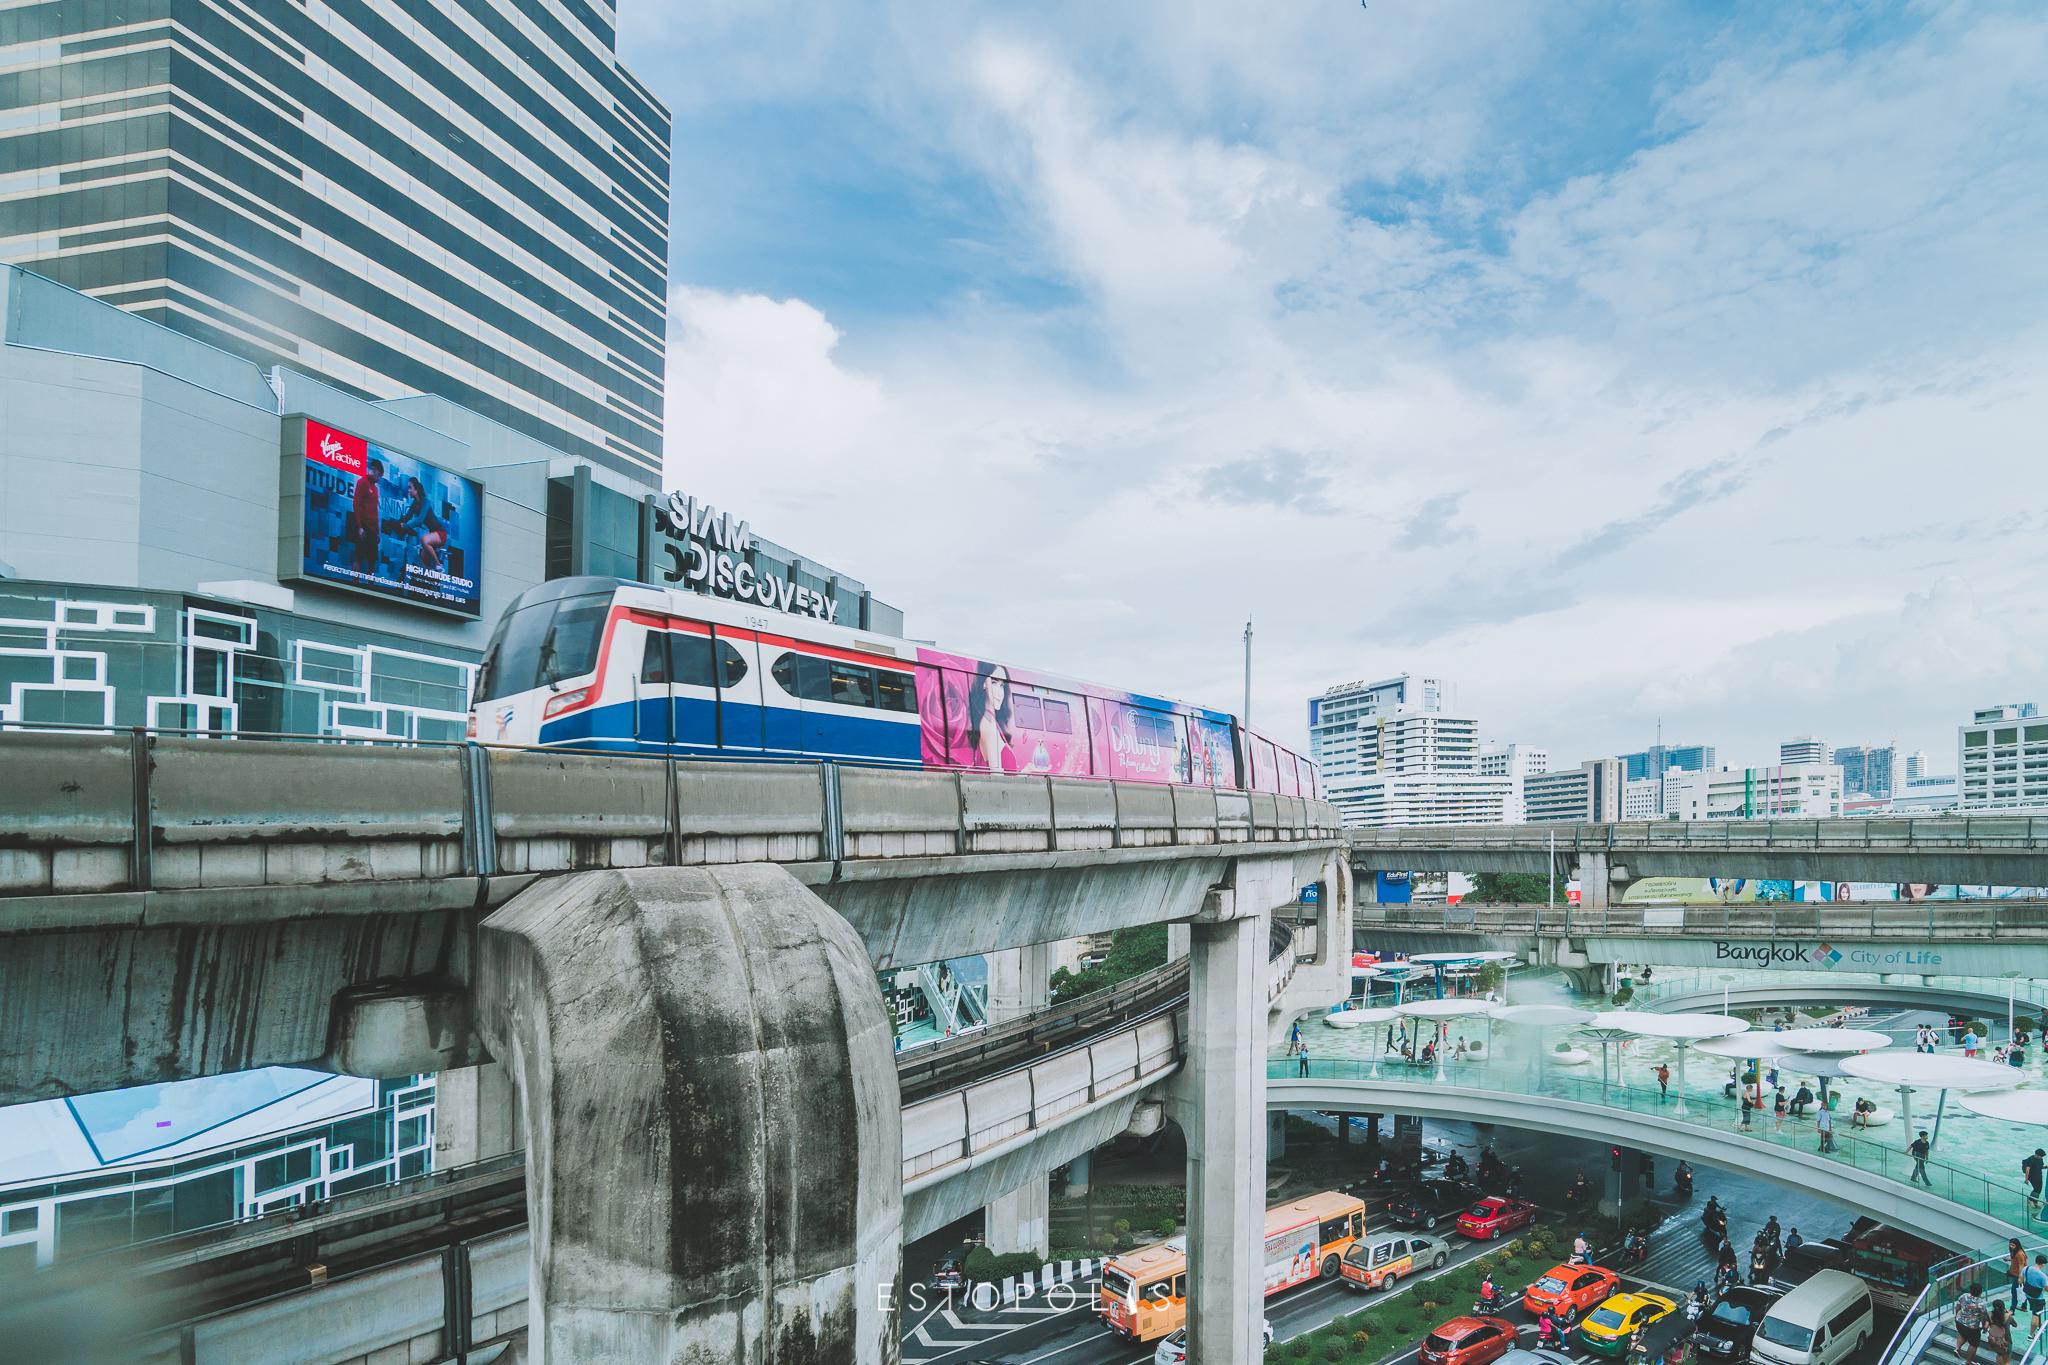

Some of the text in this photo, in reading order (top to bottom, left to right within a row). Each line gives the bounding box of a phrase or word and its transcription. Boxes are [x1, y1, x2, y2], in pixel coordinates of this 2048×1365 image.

[320, 433, 343, 461] Virgin
[335, 453, 361, 468] active
[668, 489, 750, 553] SIAM
[405, 563, 424, 576] HIGH
[424, 567, 452, 583] ALTITUDE
[451, 575, 473, 589] STUDIO
[688, 541, 838, 624] DISCOVERY
[1713, 941, 1942, 968] Bangkok City of Life
